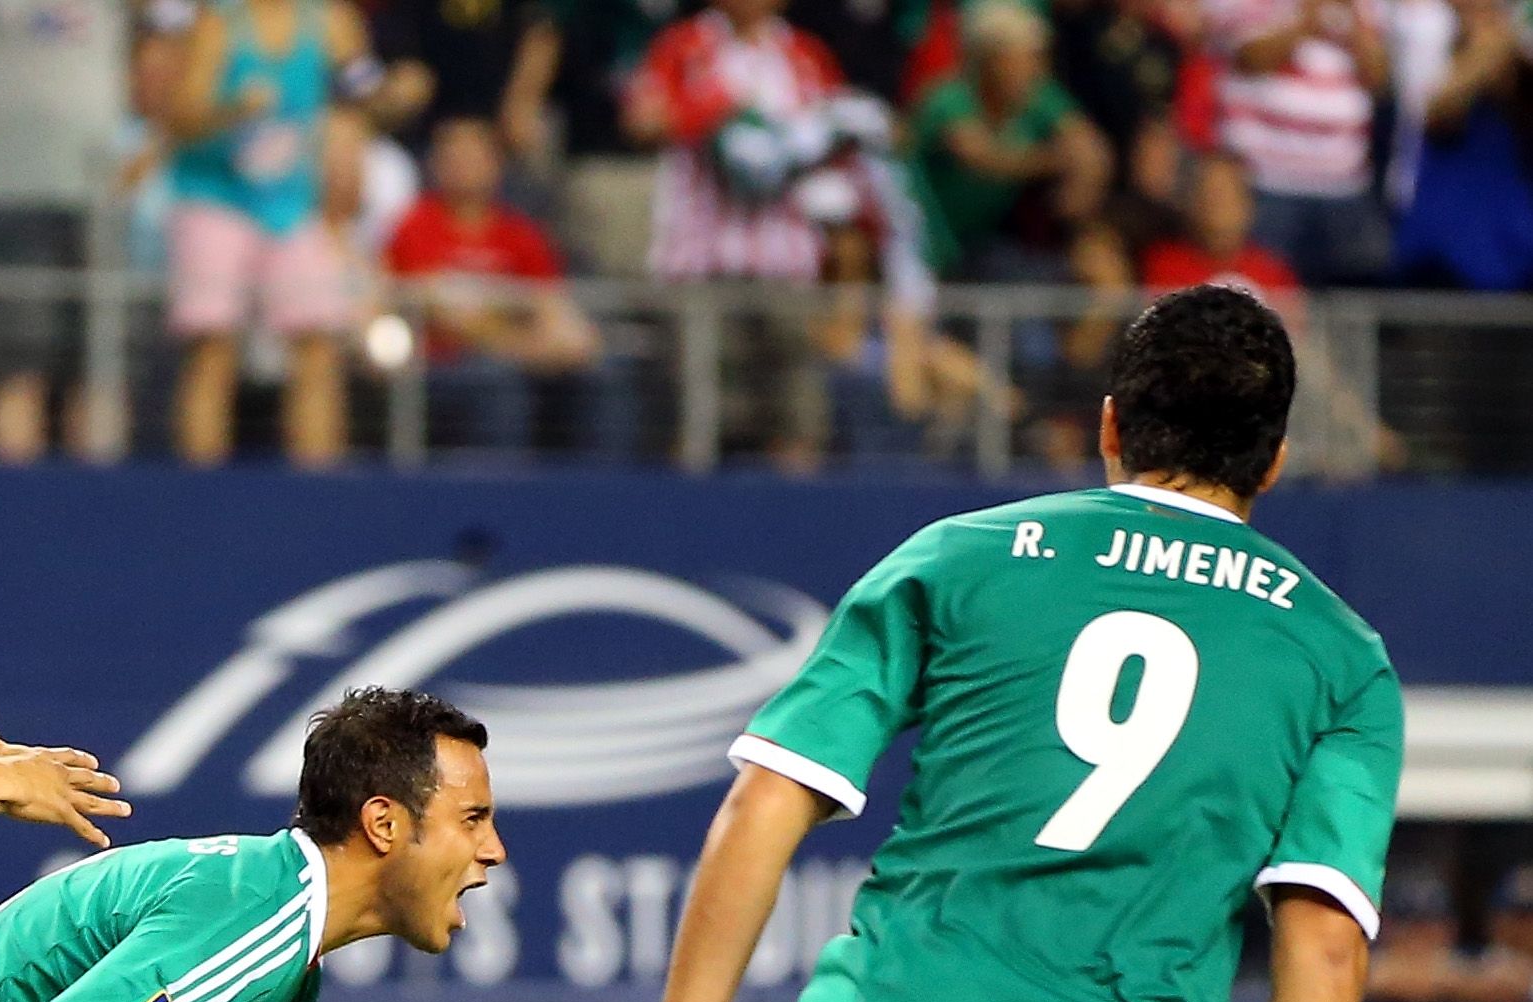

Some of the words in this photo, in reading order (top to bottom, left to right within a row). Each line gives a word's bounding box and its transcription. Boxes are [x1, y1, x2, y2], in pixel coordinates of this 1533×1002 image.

[1011, 520, 1056, 559] R.
[1095, 529, 1300, 609] JIMENEZ
[1033, 609, 1200, 853] 9
